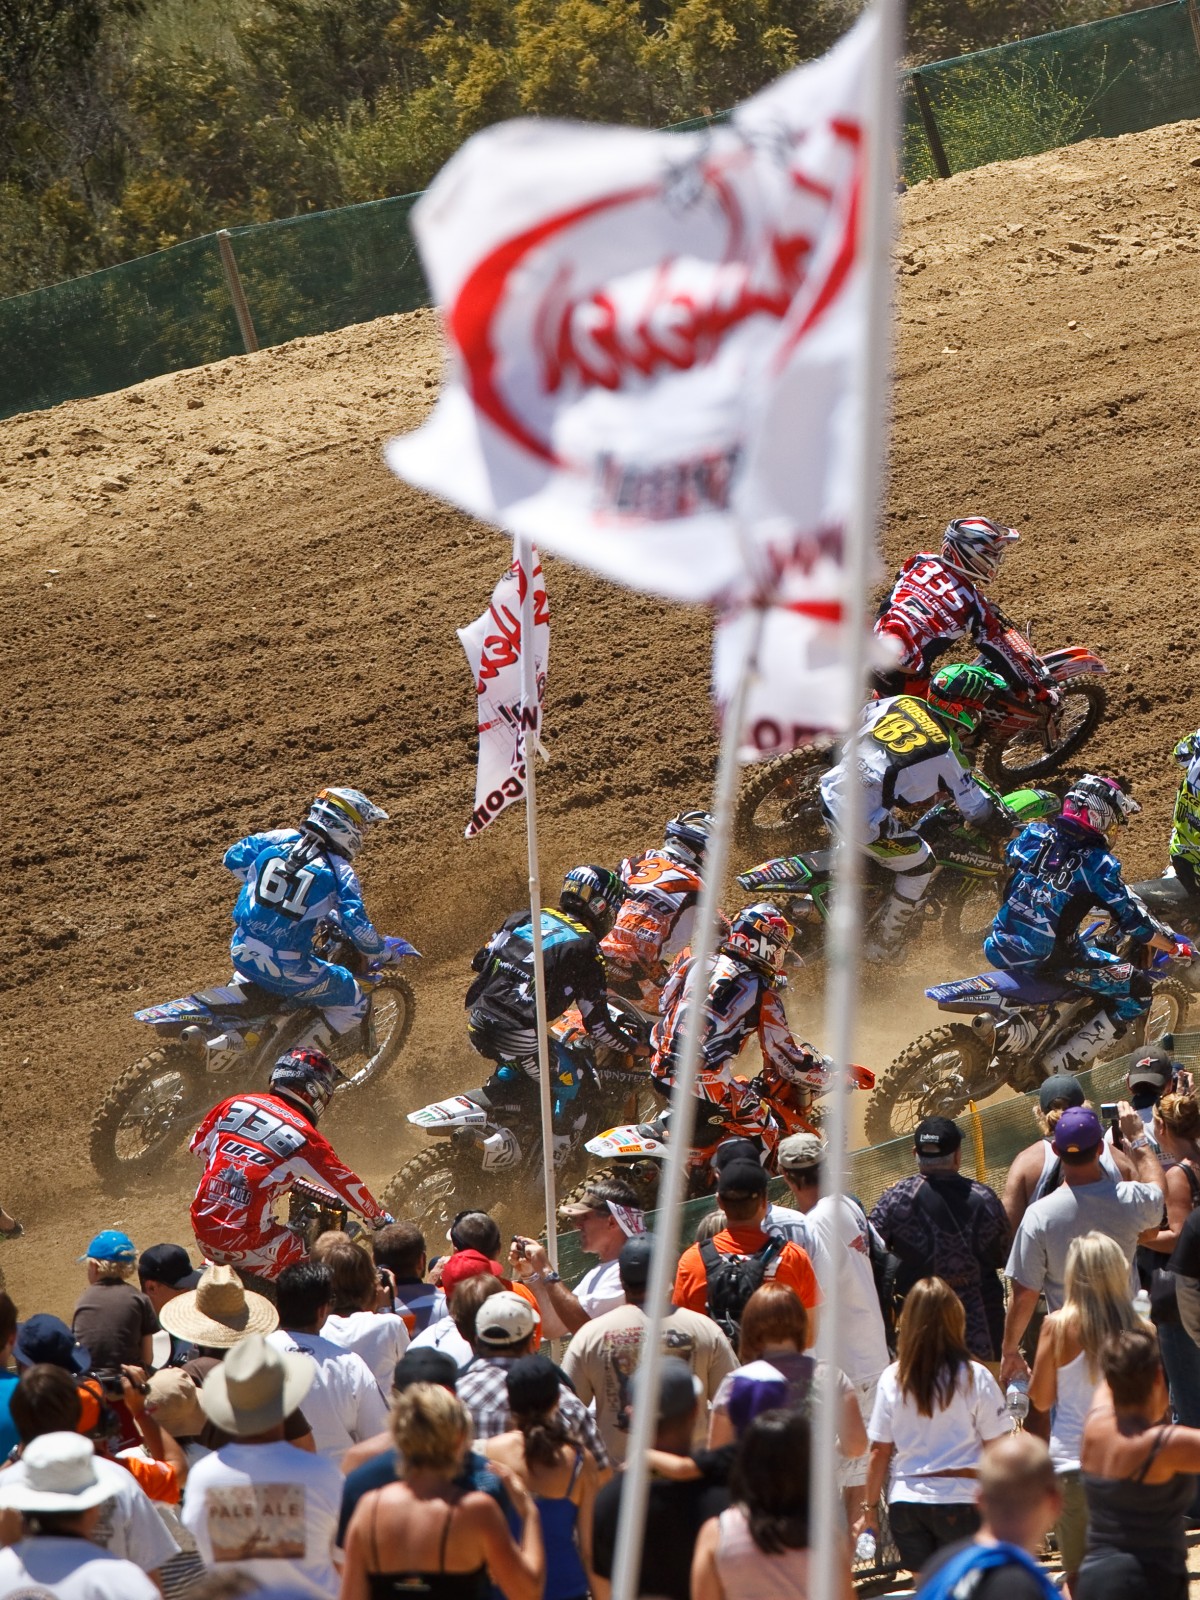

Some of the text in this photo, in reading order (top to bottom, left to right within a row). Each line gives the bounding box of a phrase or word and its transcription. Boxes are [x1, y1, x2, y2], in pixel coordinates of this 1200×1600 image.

[911, 561, 975, 611] 335
[872, 711, 928, 756] 183
[949, 851, 1004, 870] MONSTER
[257, 856, 318, 917] 61
[627, 856, 704, 895] 37
[499, 960, 531, 981] MONSTER
[592, 1020, 630, 1053] YAMAHA
[217, 1100, 308, 1158] 338
[221, 1140, 274, 1167] UFO
[208, 1178, 230, 1196] WILD
[229, 1185, 252, 1205] WOLF
[295, 1178, 338, 1199] RENTHAL
[208, 1503, 300, 1519] PALE ALE
